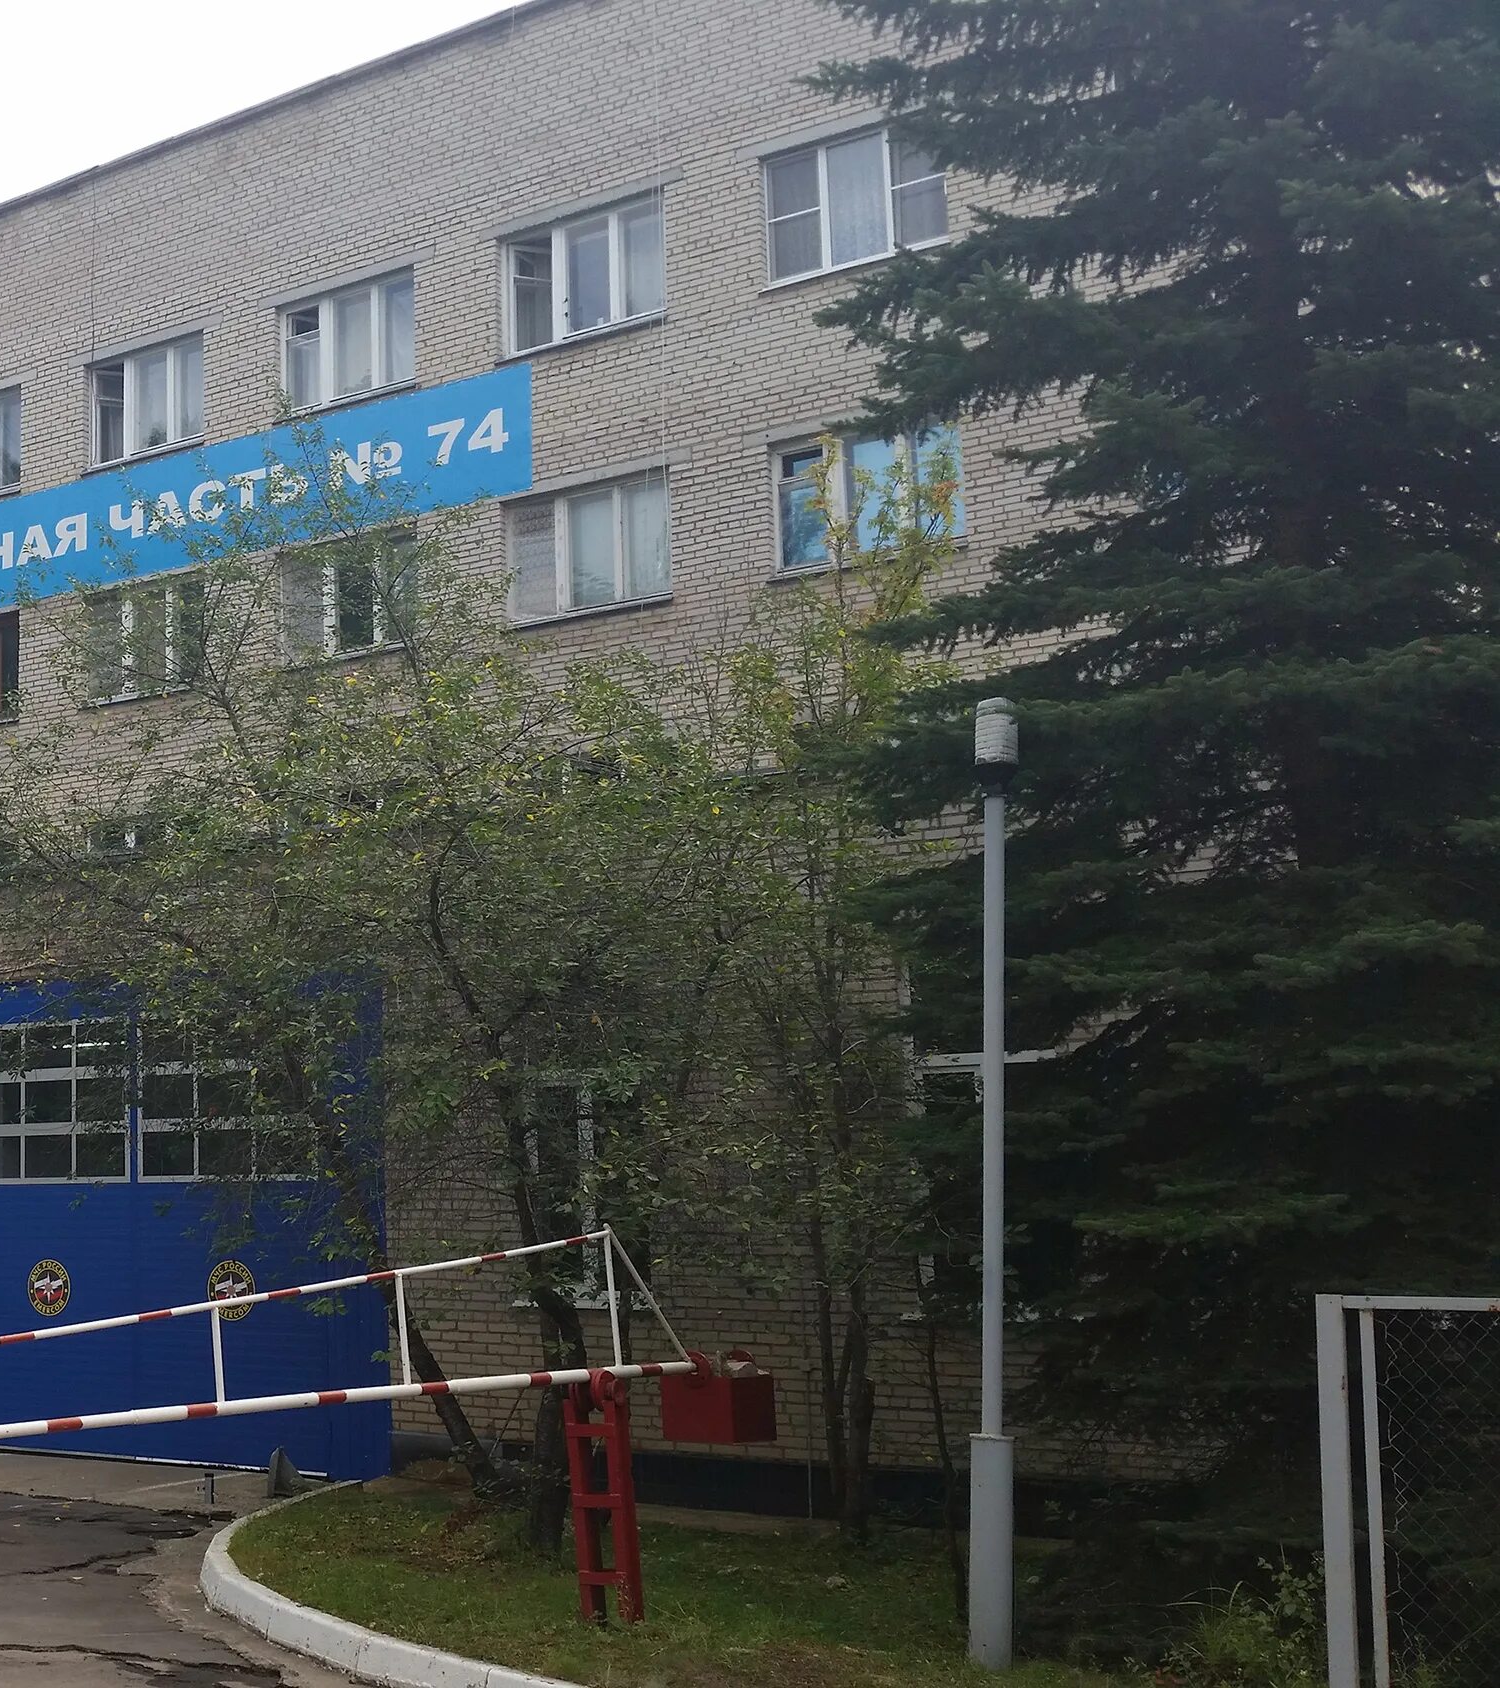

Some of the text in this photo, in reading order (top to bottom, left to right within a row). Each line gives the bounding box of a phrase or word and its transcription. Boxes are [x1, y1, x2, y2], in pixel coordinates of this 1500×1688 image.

[109, 464, 308, 540] ЧАСТЬ
[328, 438, 403, 490] №
[428, 408, 510, 466] 74
